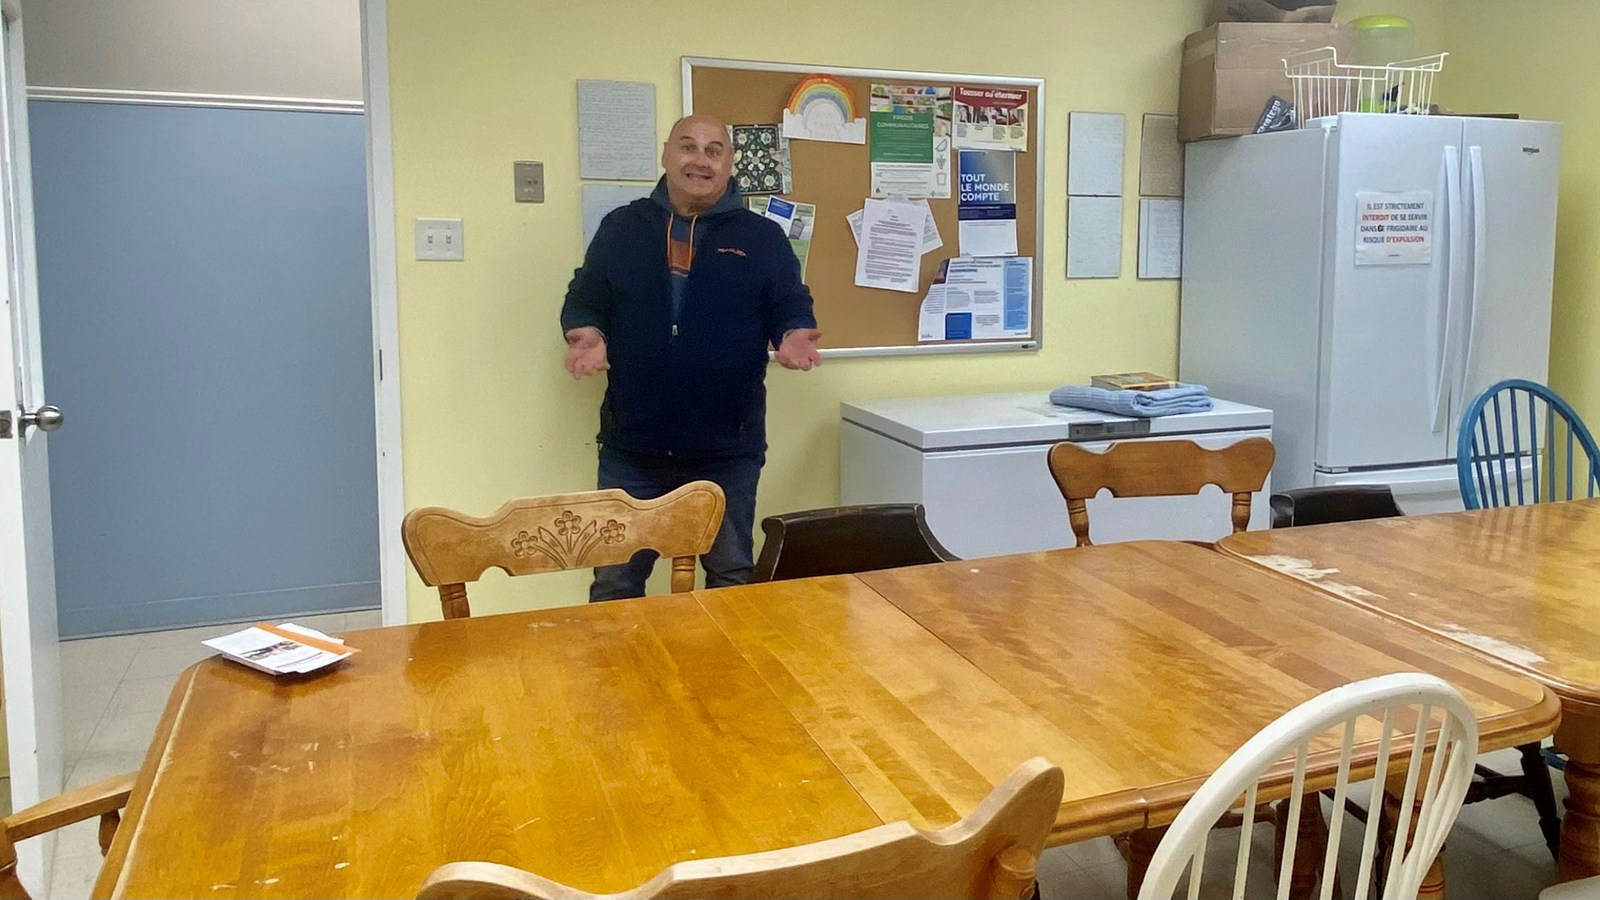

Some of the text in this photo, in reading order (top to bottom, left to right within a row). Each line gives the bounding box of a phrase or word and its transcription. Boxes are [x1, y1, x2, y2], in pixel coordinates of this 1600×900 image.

[960, 87, 984, 97] Tousser
[961, 173, 986, 182] TOUT
[961, 183, 1010, 192] LE MONDE
[961, 192, 1000, 201] COMPTE
